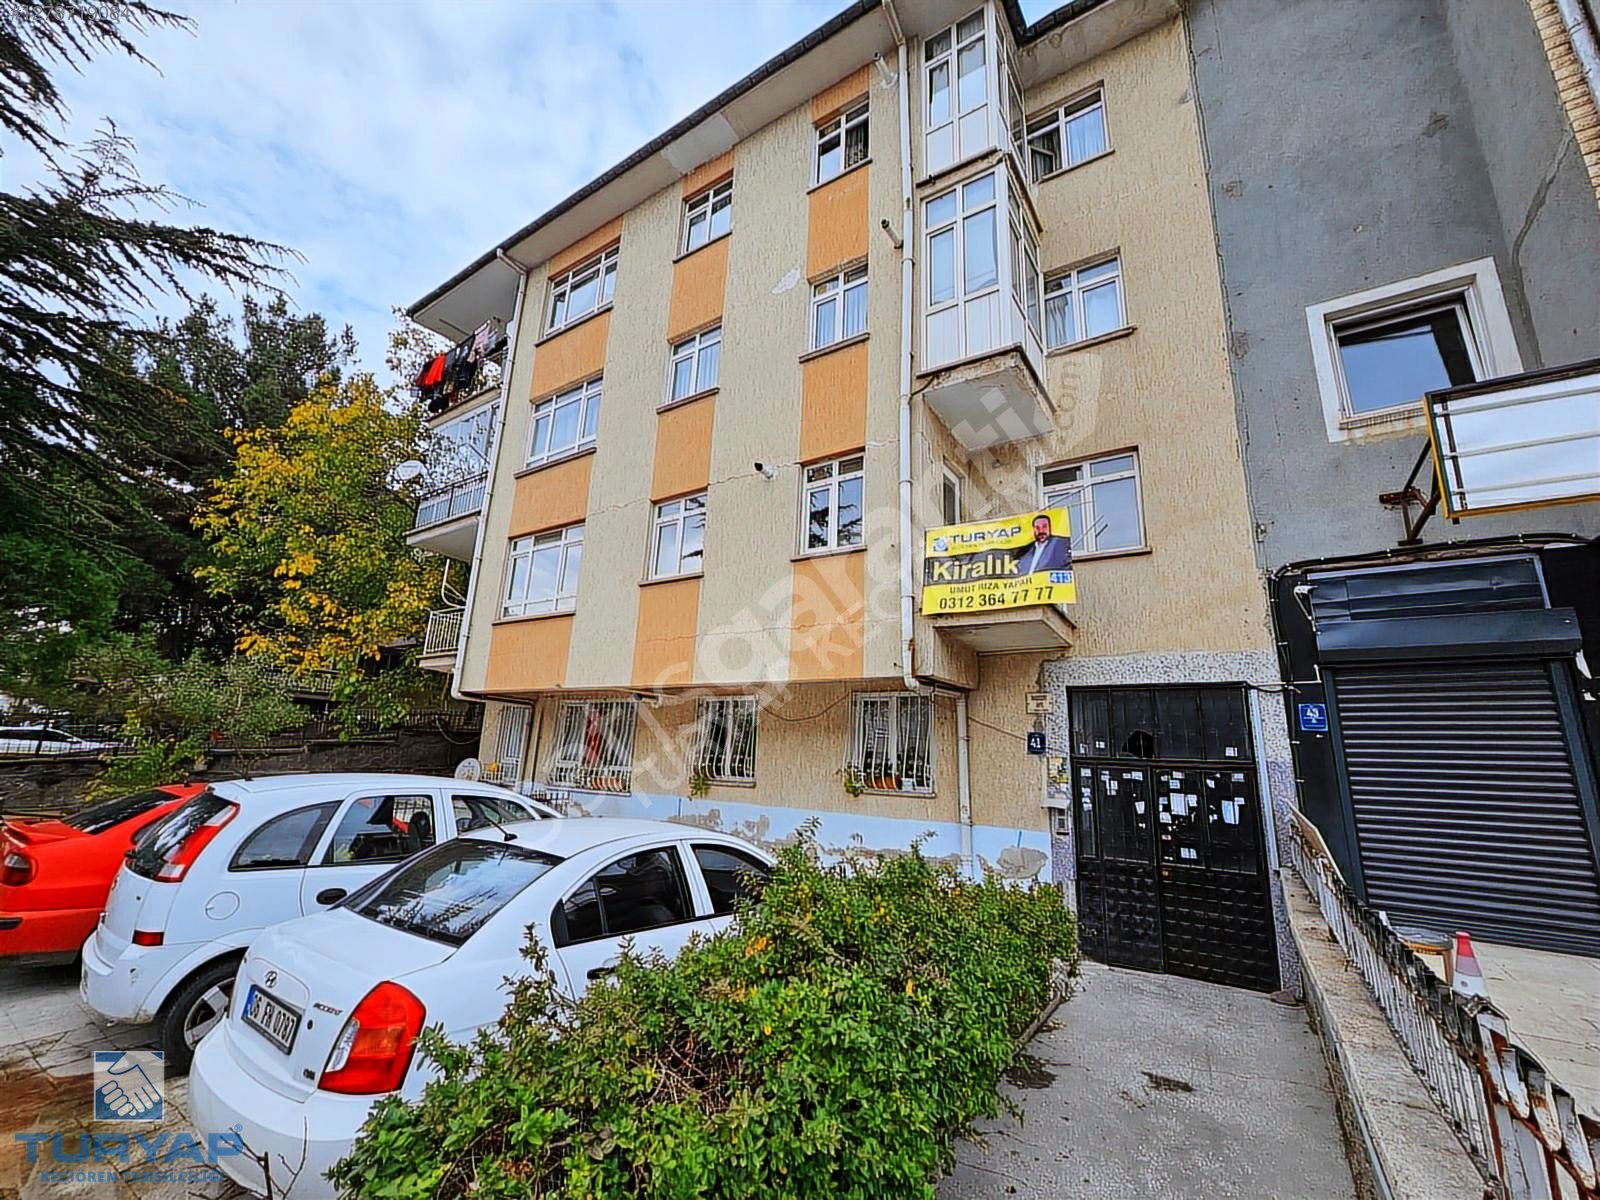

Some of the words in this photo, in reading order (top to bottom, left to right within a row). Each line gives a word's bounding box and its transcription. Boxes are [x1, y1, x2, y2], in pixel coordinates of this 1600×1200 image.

[951, 526, 1022, 544] TURYAP
[932, 553, 1020, 582] Kiralık
[939, 596, 974, 609] 0312
[979, 593, 1005, 607] 364
[1011, 589, 1029, 604] 77
[1034, 586, 1054, 600] 77
[949, 585, 975, 594] UMUT
[1030, 737, 1041, 749] 41
